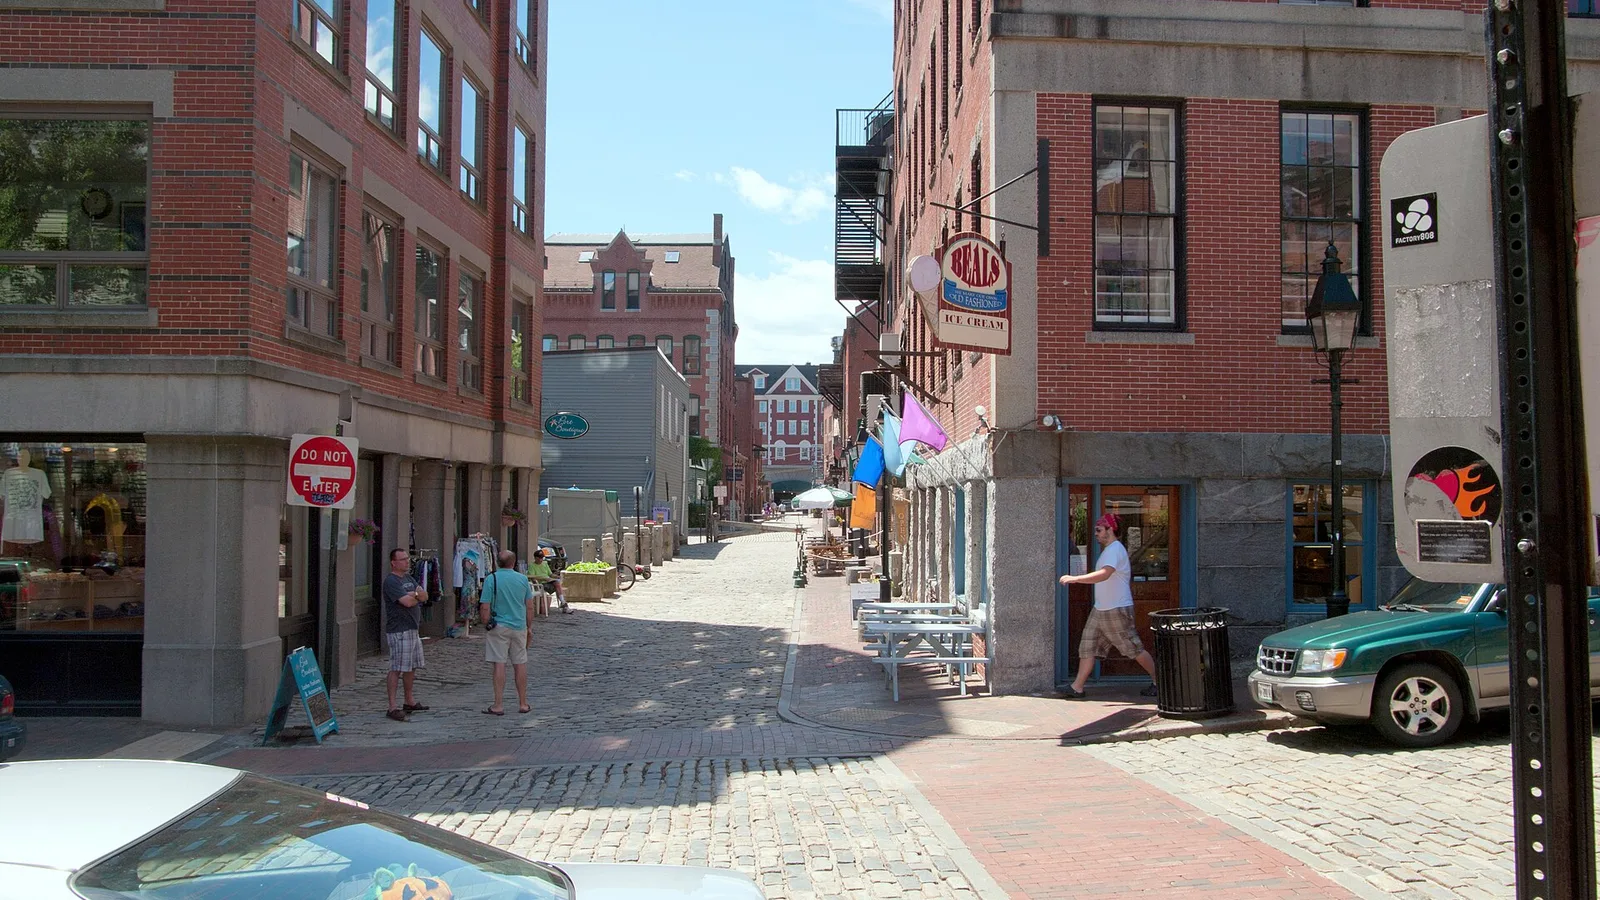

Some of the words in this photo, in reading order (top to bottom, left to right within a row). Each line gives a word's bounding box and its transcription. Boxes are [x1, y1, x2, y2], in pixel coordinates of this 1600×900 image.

[1395, 231, 1435, 244] FACTORY808
[950, 241, 1000, 288] BEALS
[949, 293, 963, 302] OLD
[965, 296, 1003, 308] FASHIONED
[945, 314, 963, 325] ICE
[967, 317, 1004, 330] CREAM
[301, 449, 317, 461] DO
[323, 450, 348, 463] NOT
[303, 480, 341, 493] ENTER
